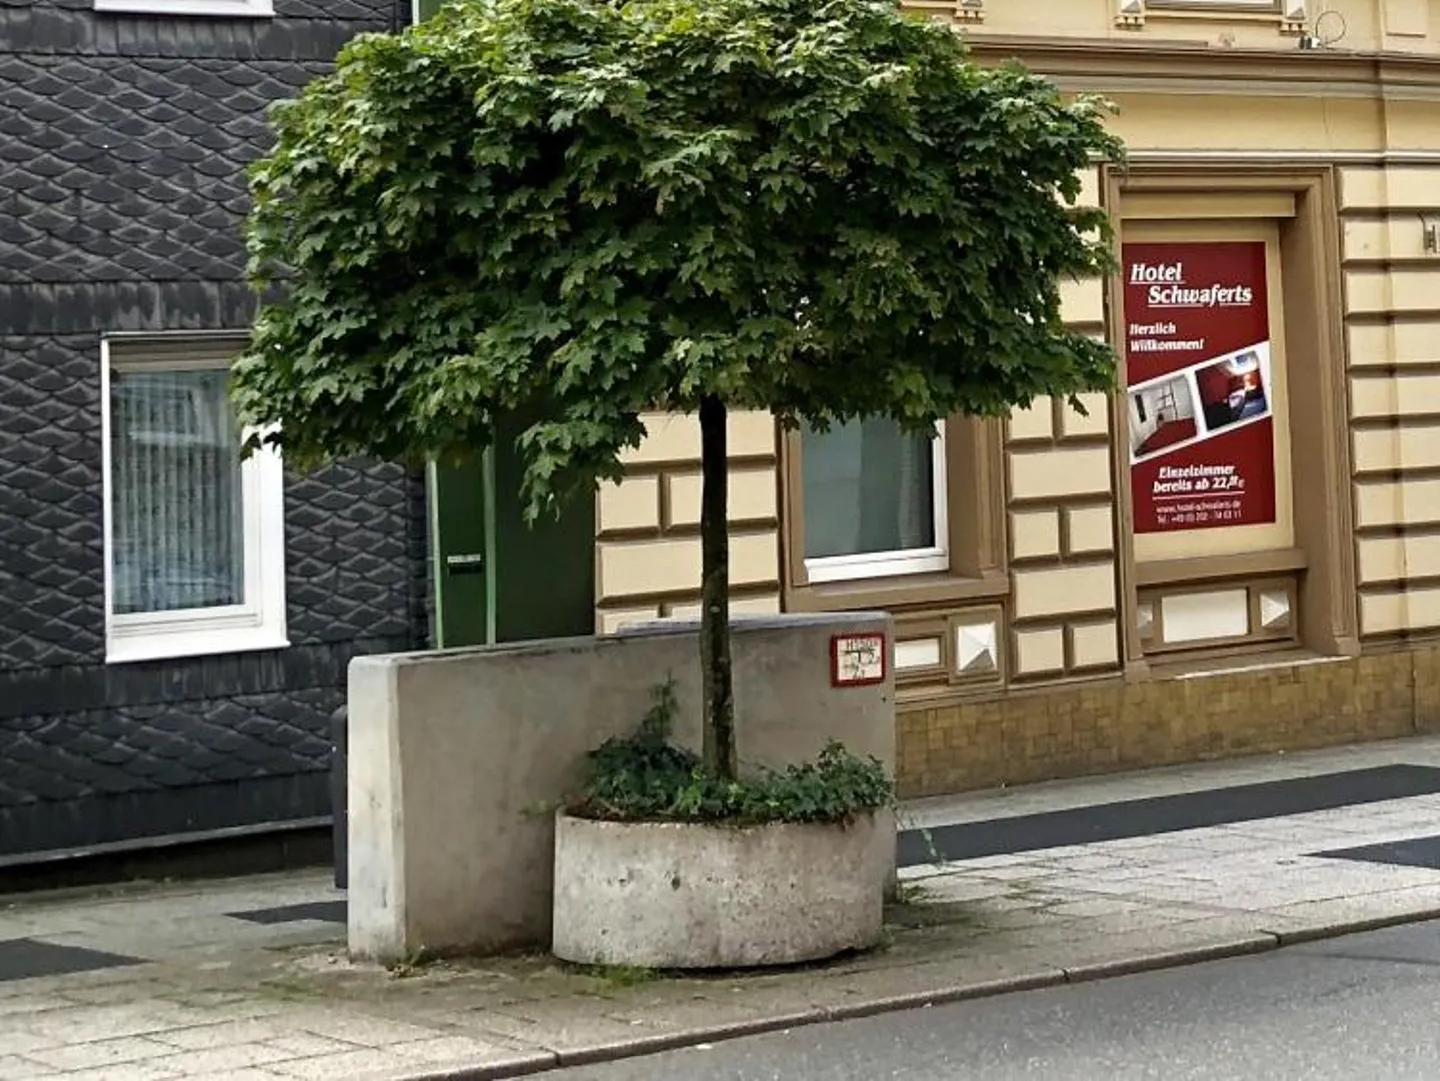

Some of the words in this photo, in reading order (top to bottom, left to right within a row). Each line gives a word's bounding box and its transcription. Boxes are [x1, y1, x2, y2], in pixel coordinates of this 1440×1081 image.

[1129, 261, 1183, 283] Hotel
[1147, 283, 1253, 307] Schwaferts
[1129, 321, 1177, 335] Herzlich
[1130, 338, 1205, 353] Willkommen!
[1159, 464, 1235, 478] Einzelzimmer
[1153, 479, 1192, 493] bereits
[1194, 477, 1210, 490] ab
